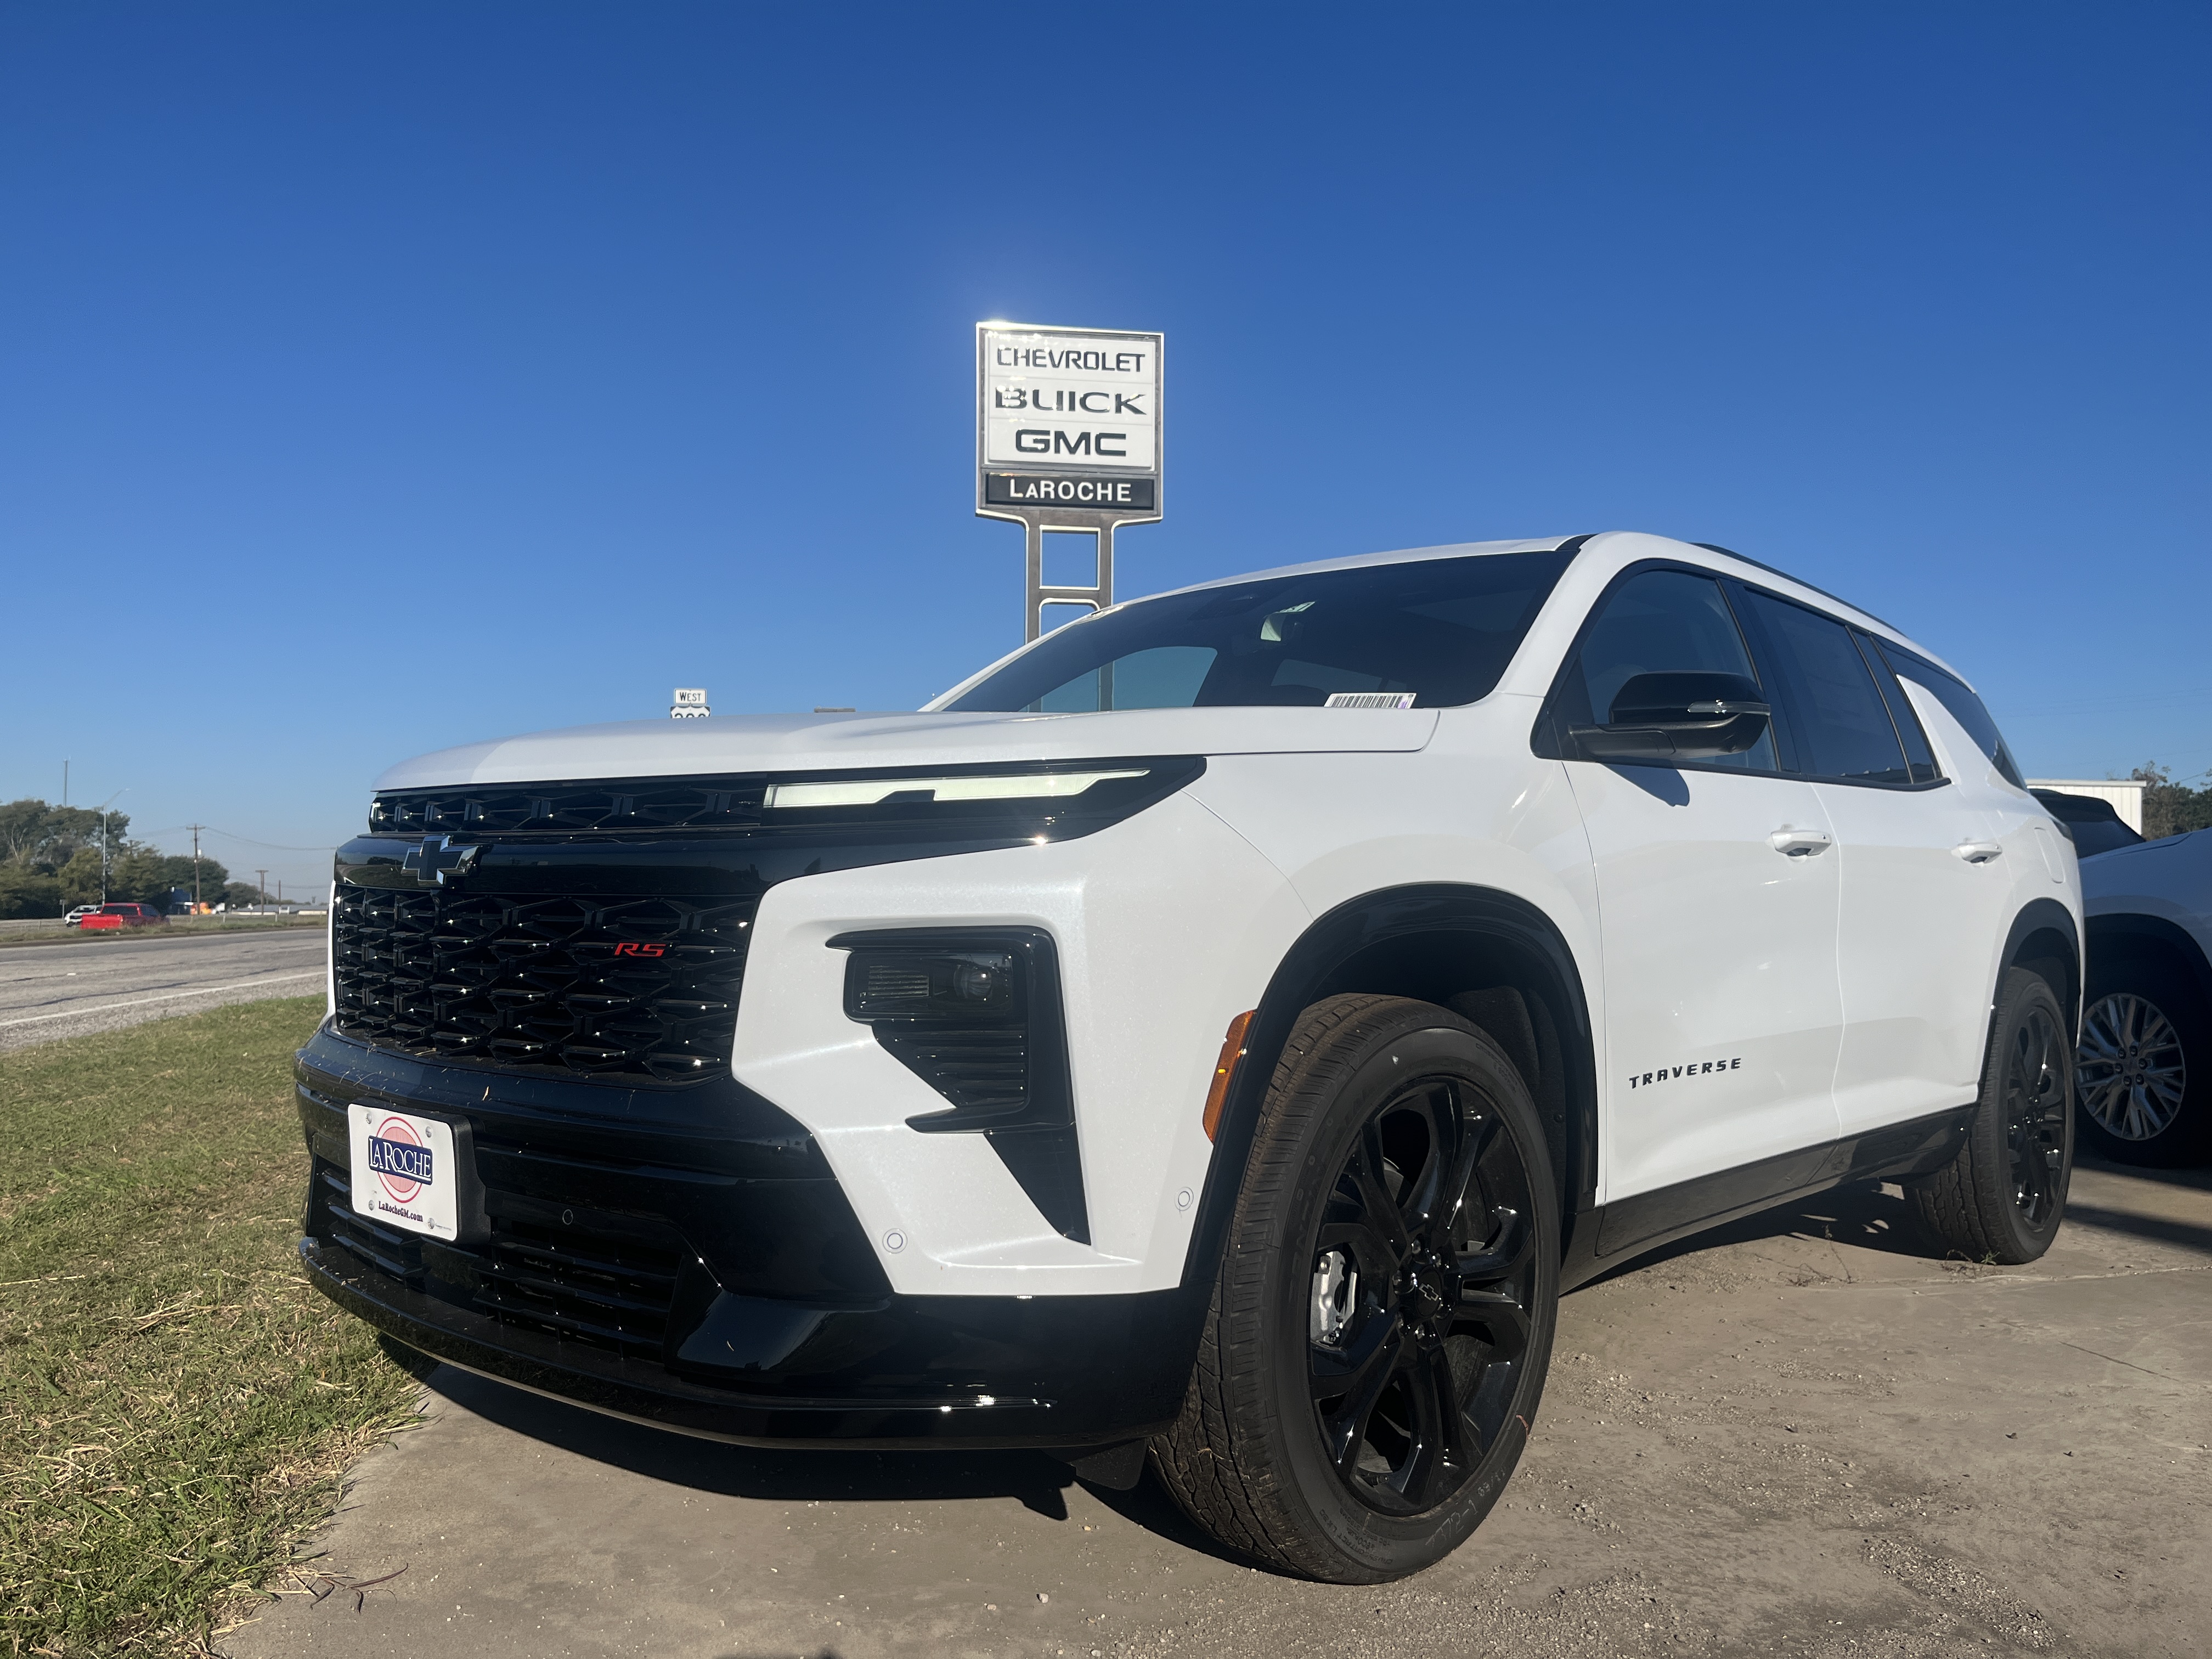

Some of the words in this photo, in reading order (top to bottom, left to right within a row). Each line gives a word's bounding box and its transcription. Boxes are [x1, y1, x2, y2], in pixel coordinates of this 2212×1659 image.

[997, 347, 1146, 373] CHEVROLET
[995, 387, 1147, 415] BUICK
[1015, 429, 1126, 456] GMC
[680, 692, 701, 702] WEST
[614, 943, 667, 957] RS
[1629, 1058, 1741, 1089] TRAVERSE
[379, 1200, 423, 1222] LaRocheGM.com
